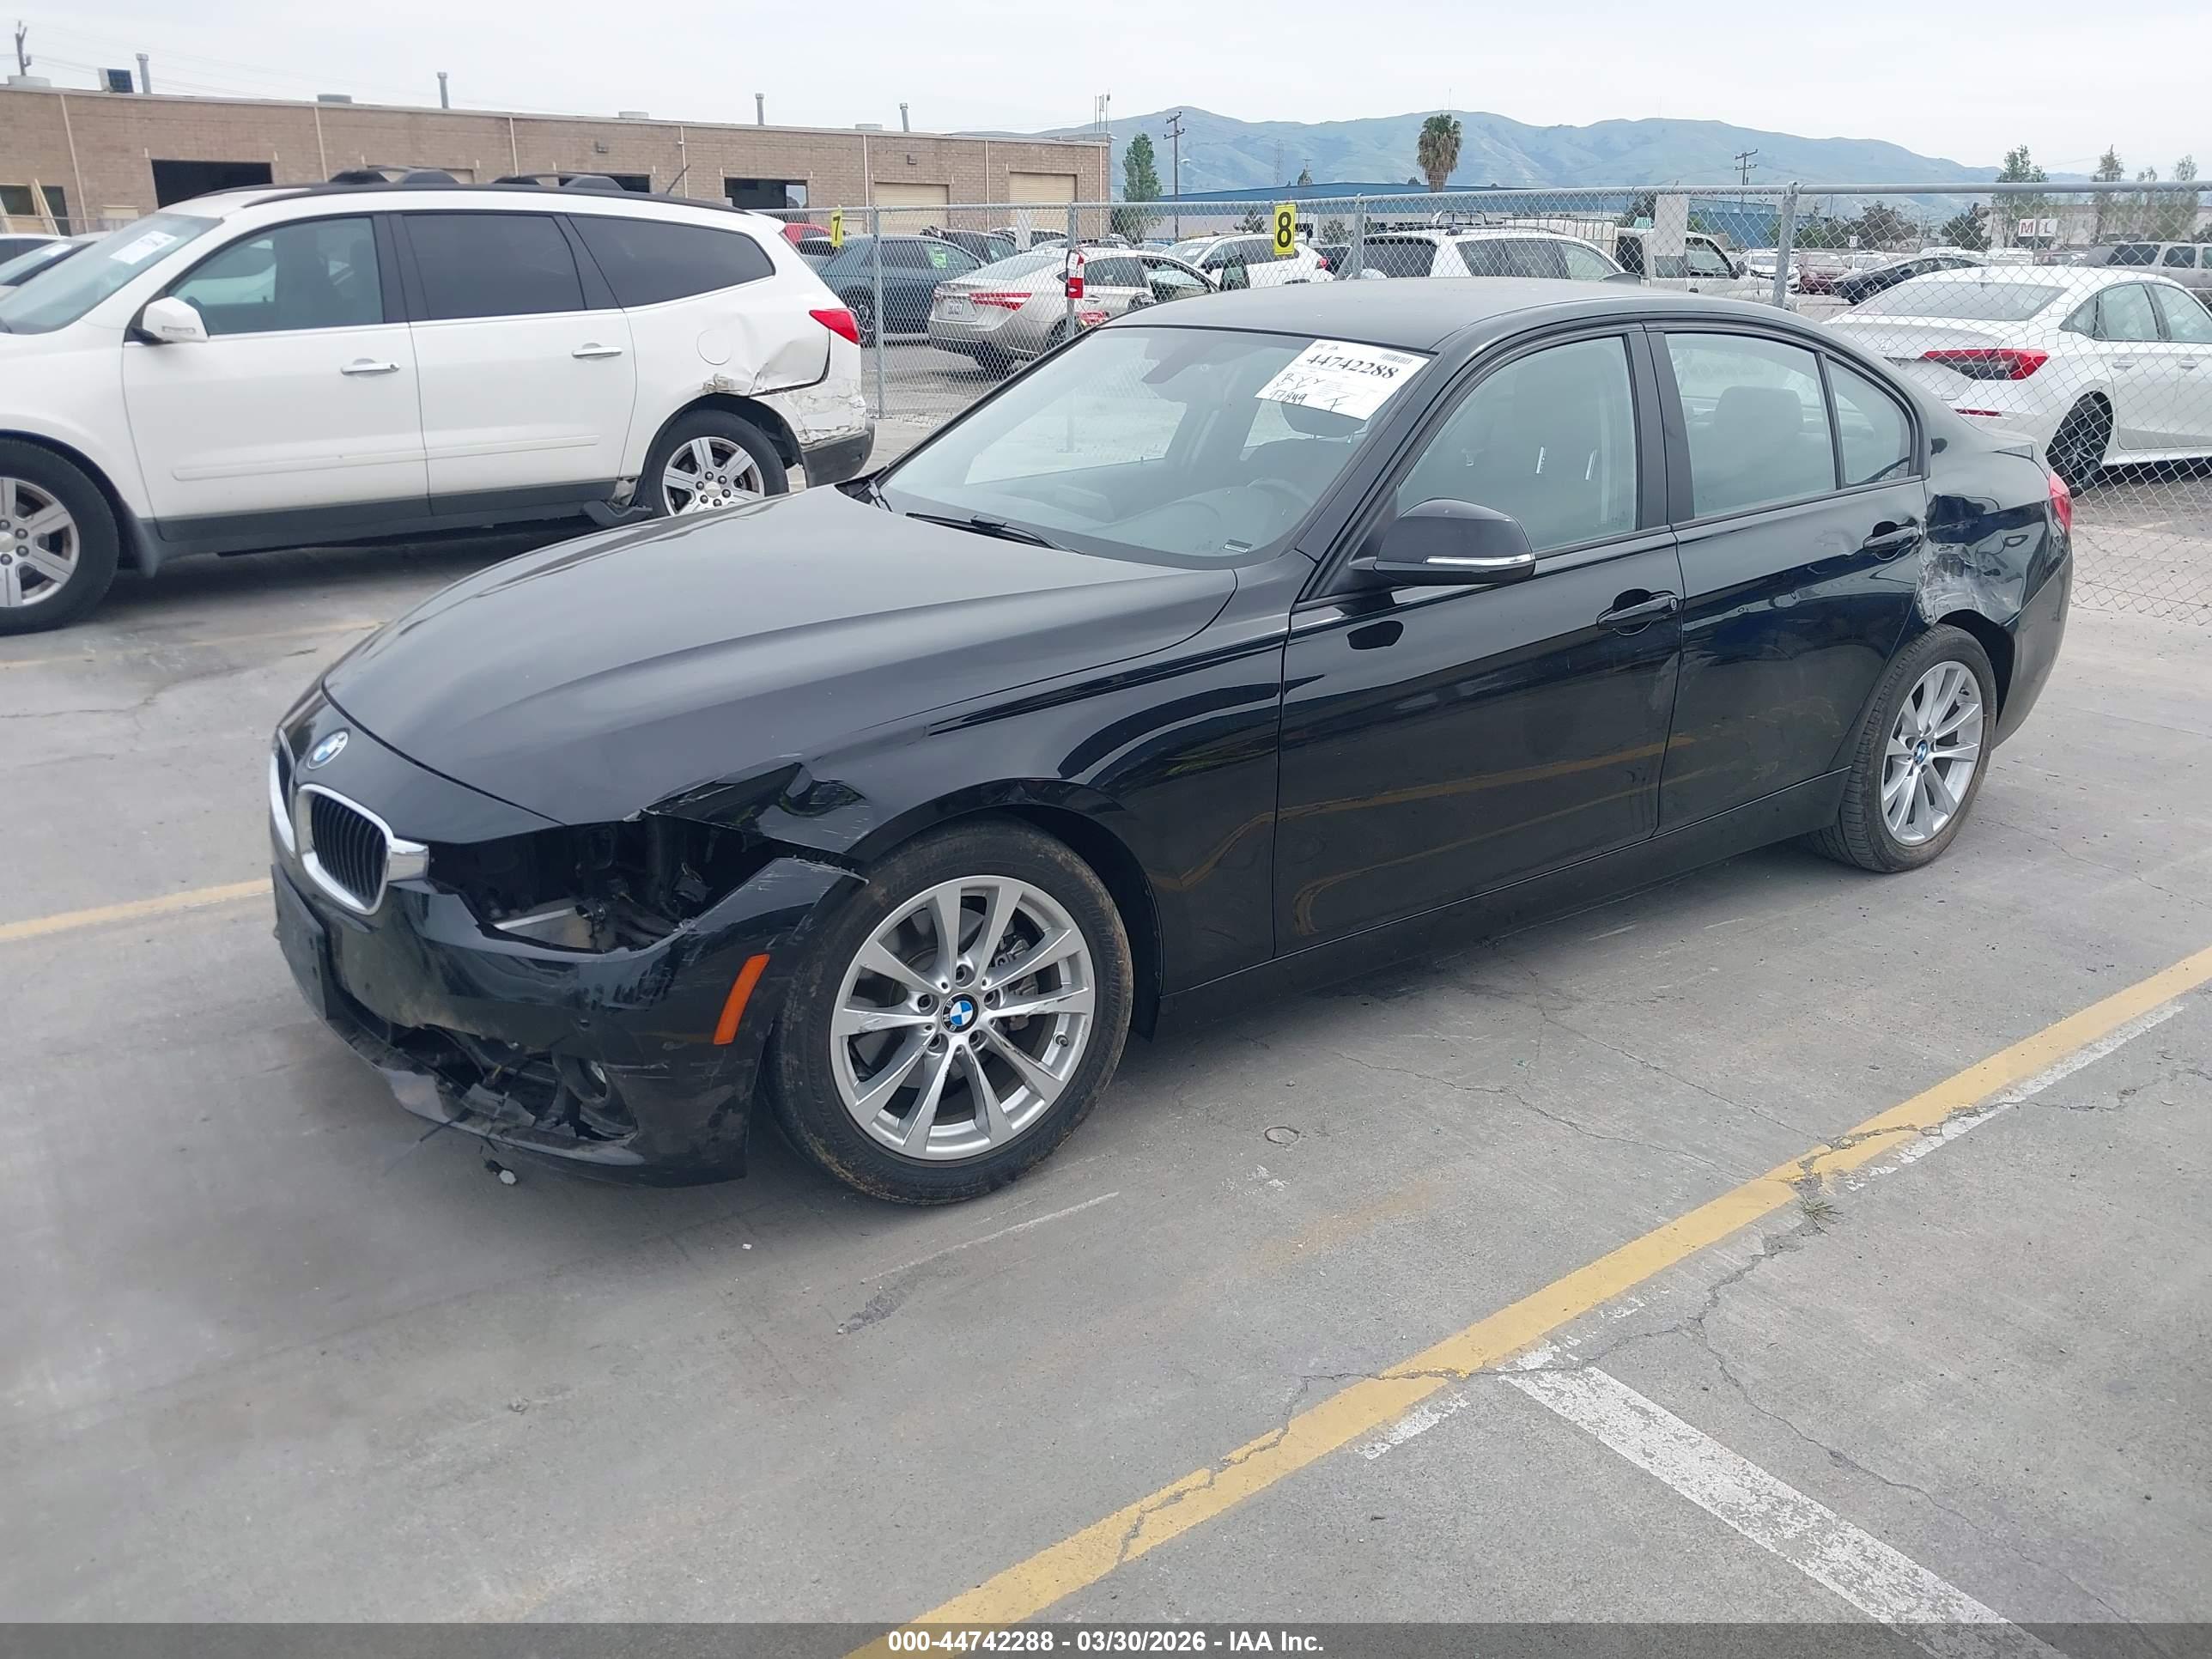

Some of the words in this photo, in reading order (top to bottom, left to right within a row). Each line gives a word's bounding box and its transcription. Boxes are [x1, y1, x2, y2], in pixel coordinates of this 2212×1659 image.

[832, 216, 841, 241] 7
[1277, 211, 1291, 248] 8
[1306, 354, 1399, 379] 44742288
